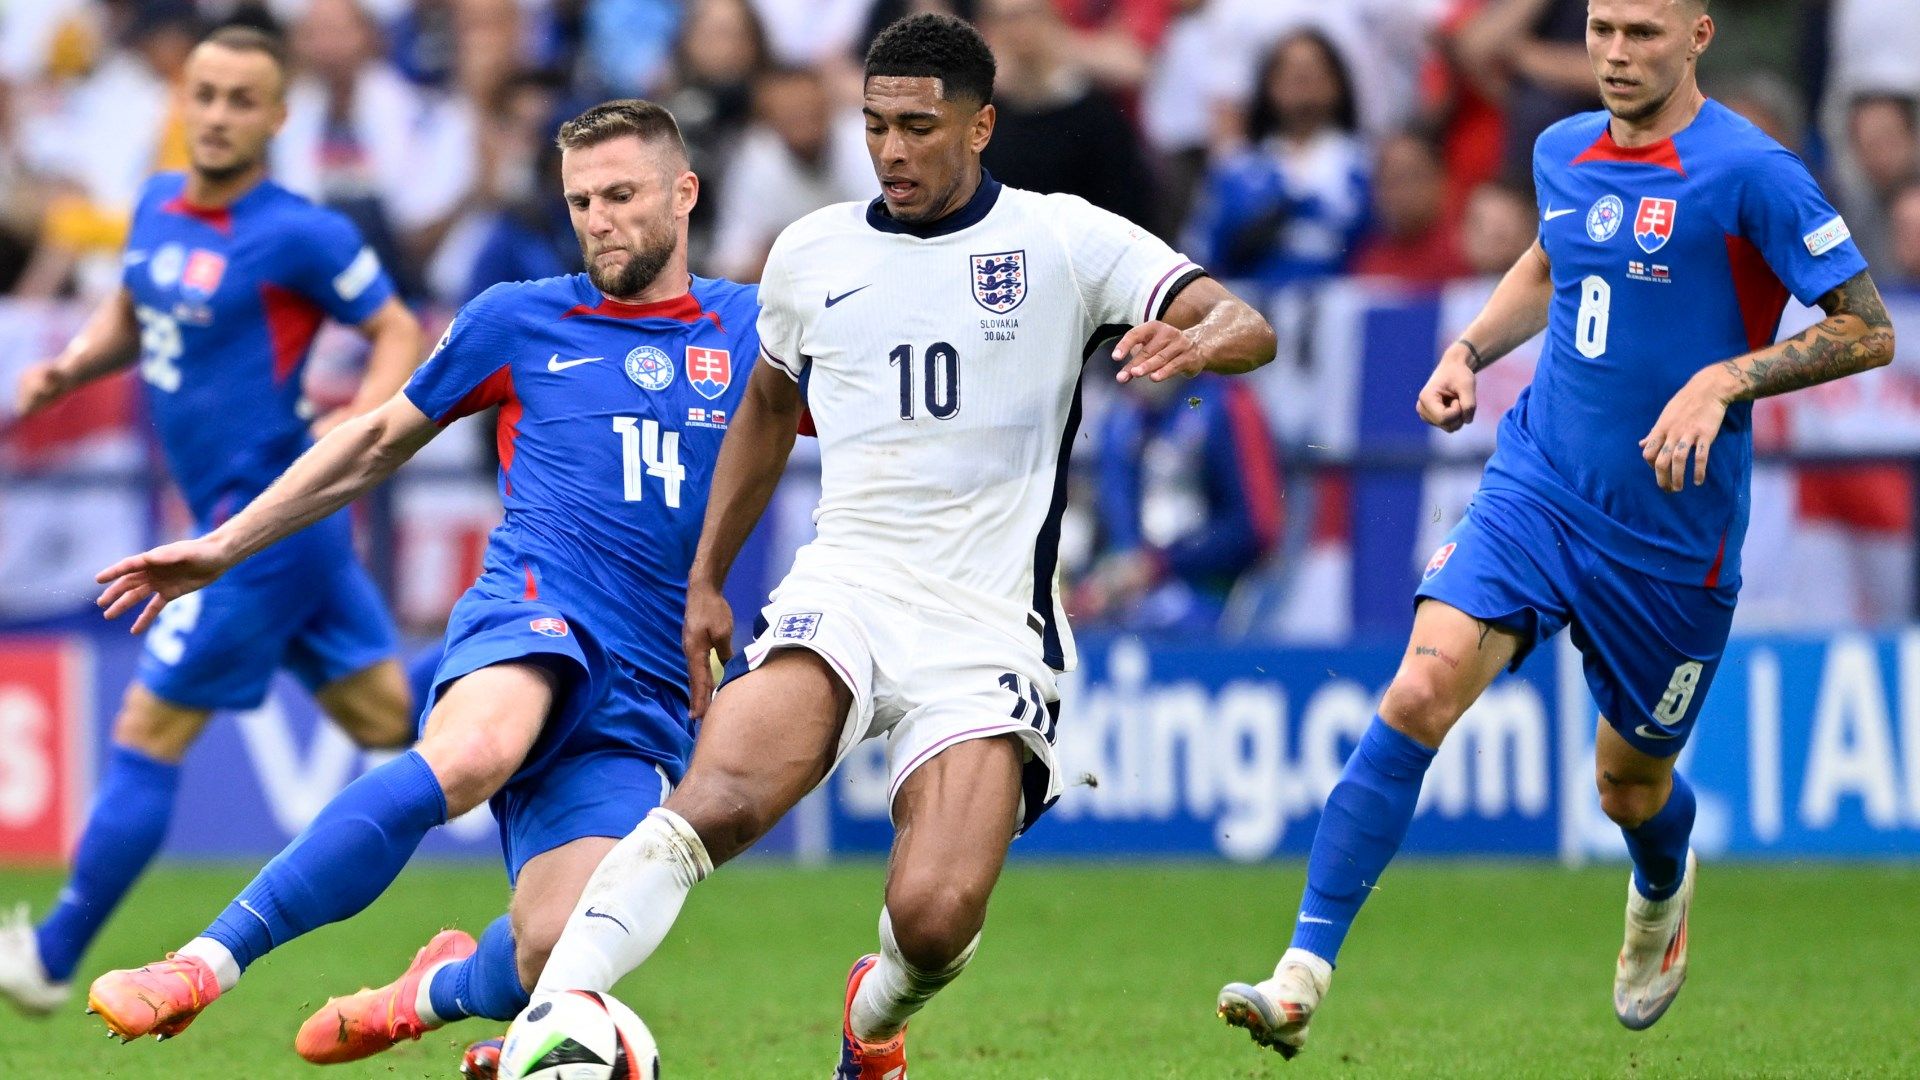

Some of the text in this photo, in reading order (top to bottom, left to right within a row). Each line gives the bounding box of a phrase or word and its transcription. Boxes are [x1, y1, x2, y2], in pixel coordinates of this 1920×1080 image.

[980, 319, 1019, 329] SLOVAKIA
[984, 331, 1015, 341] 30.06.24
[1575, 275, 1611, 359] 8
[889, 341, 961, 420] 10
[612, 416, 685, 508] 14
[1652, 661, 1703, 725] 8
